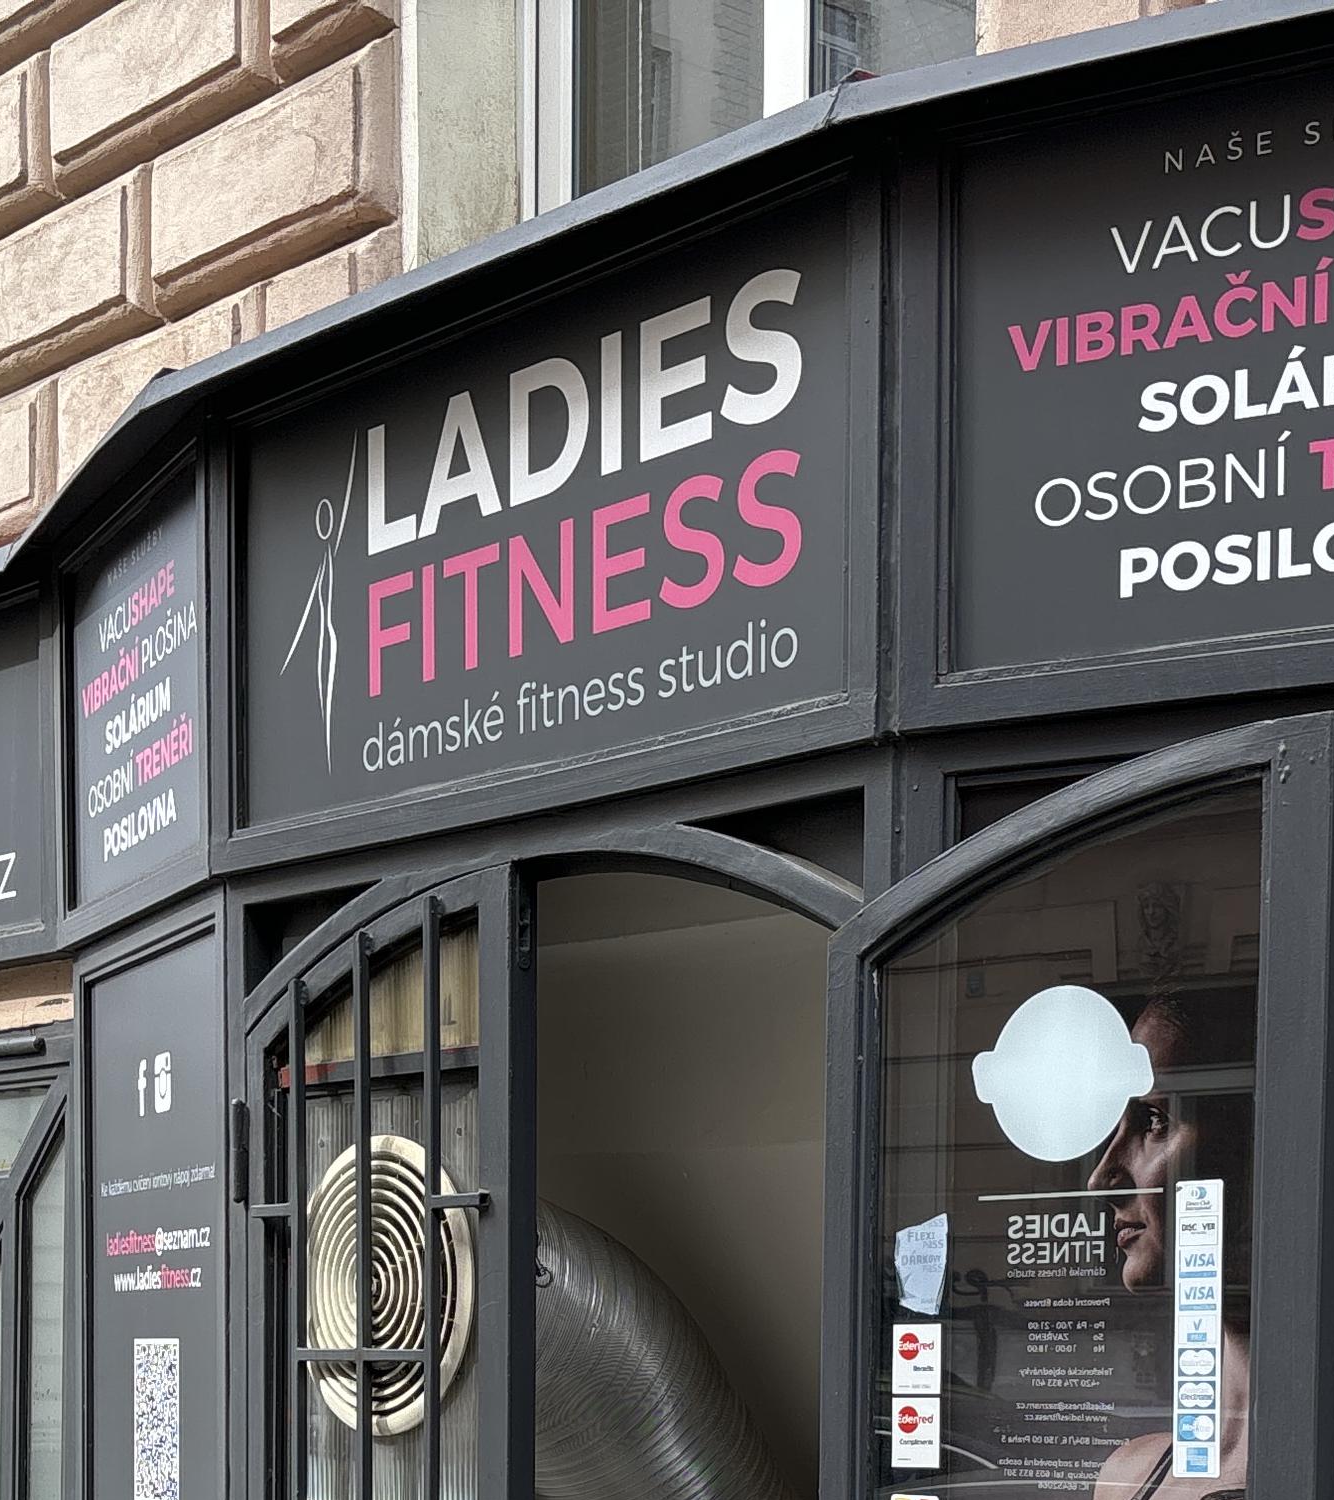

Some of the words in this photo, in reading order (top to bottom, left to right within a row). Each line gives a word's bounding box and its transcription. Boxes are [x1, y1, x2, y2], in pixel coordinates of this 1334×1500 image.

[1163, 128, 1276, 175] NAŠE
[1007, 256, 1331, 375] VIBRAČNÍ
[366, 268, 802, 556] LADIES
[1034, 430, 1288, 529] OSOBNÍ
[98, 559, 175, 653] VACUSHAPE
[367, 449, 802, 698] FITNESS
[82, 635, 139, 719] VIBRAČNÍ
[141, 600, 198, 675] PLOŠINA
[362, 689, 505, 773] dámské
[517, 664, 645, 735] fitness
[658, 620, 799, 699] studio
[105, 676, 171, 754] SOLÁRIUM
[88, 750, 133, 818] OSOBNÍ
[136, 711, 193, 786] TRENÉŘI
[103, 788, 177, 862] POSILOVNA
[106, 1226, 210, 1257] ladiesfitness@seznam.cz
[113, 1263, 202, 1292] www.ladiesfitness.cz
[1184, 1253, 1215, 1267] VISA
[1184, 1286, 1215, 1300] VISA
[898, 1340, 934, 1350] Edenred
[897, 1413, 934, 1424] Edenred
